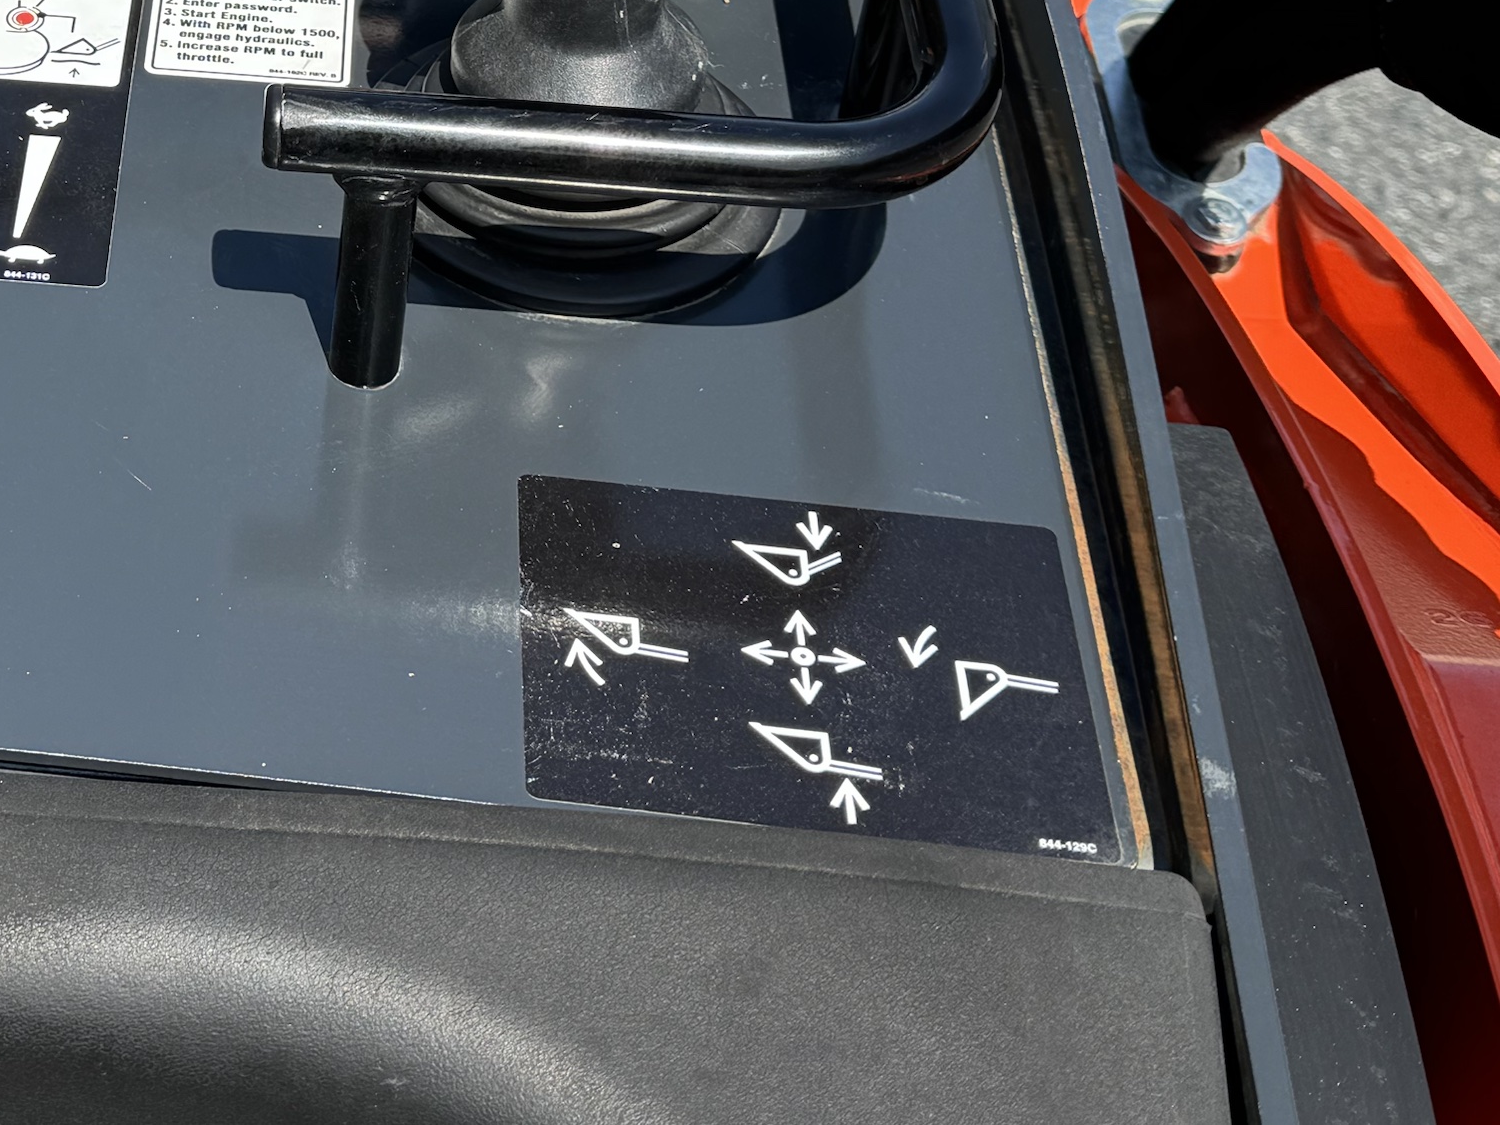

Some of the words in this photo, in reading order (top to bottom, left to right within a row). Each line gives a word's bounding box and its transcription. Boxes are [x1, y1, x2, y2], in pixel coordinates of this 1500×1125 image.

[164, 8, 177, 16] 3.
[181, 9, 216, 19] Start
[221, 11, 273, 23] Engine.
[224, 2, 297, 14] password.
[163, 18, 175, 27] 4.
[180, 19, 211, 29] With
[216, 22, 248, 31] RPM
[253, 24, 295, 35] below
[301, 28, 340, 40] 1500,
[179, 31, 231, 42] engage
[235, 33, 315, 47] hydraulics.
[160, 39, 173, 48] 5.
[177, 40, 239, 53] Increase
[243, 46, 276, 55] RPM
[281, 49, 295, 57] to
[300, 49, 324, 60] full
[176, 52, 235, 64] throttle.
[1038, 837, 1098, 854] 844-129C
